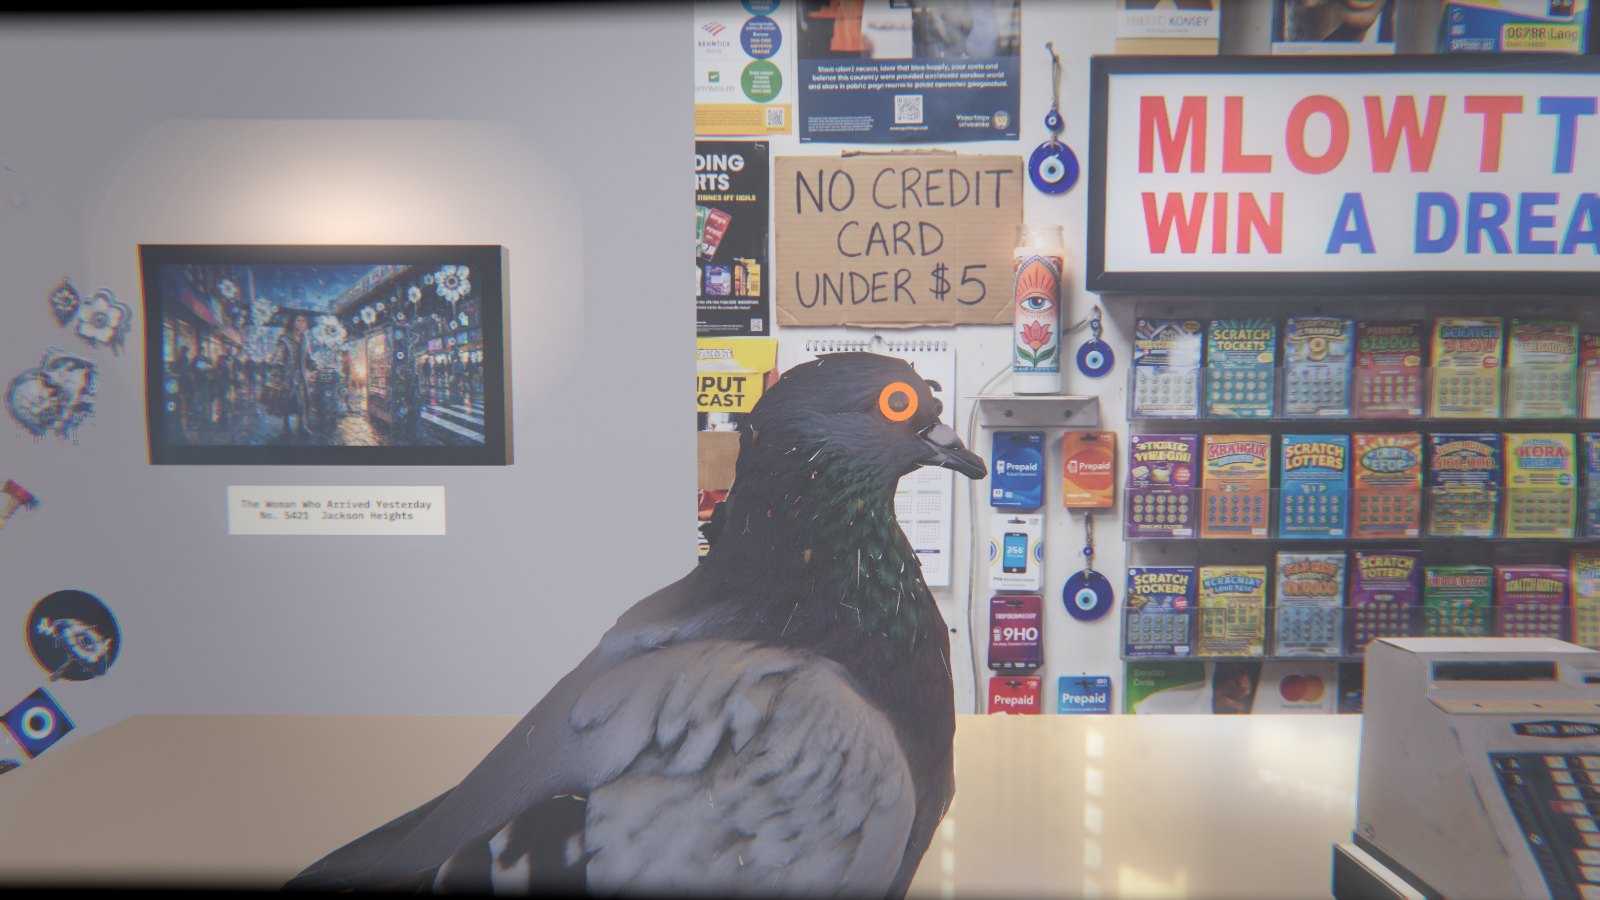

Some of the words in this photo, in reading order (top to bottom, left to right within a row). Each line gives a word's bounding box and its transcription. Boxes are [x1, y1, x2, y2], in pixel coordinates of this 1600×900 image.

[796, 169, 854, 214] NO
[872, 167, 1013, 211] CREDIT
[1141, 191, 1284, 254] WIN
[1324, 191, 1377, 254] A
[1413, 191, 1600, 254] DREA
[837, 221, 943, 257] CARD
[796, 267, 916, 308] UNDER
[929, 262, 988, 305] $5
[1214, 329, 1271, 340] SCRATCH
[1217, 340, 1266, 351] TOCKETS
[697, 393, 745, 407] CAST
[1285, 442, 1345, 458] SCRATCH
[1006, 462, 1038, 474] Prepaid
[1079, 461, 1111, 473] Prepaid
[1285, 454, 1345, 471] LOTTERS
[241, 500, 259, 508] The
[265, 500, 296, 508] Woman
[302, 500, 321, 508] Who
[326, 500, 370, 508] Arrived
[376, 500, 432, 511] Yesterday
[259, 511, 277, 519] No.
[322, 511, 364, 519] Jackson
[370, 511, 414, 522] Heights
[1360, 556, 1415, 569] SCRATCH
[1134, 573, 1189, 585] SCRATCH
[1134, 583, 1187, 595] TOCKERS
[994, 694, 1034, 707] Prepaid
[1062, 693, 1106, 706] Prepaid
